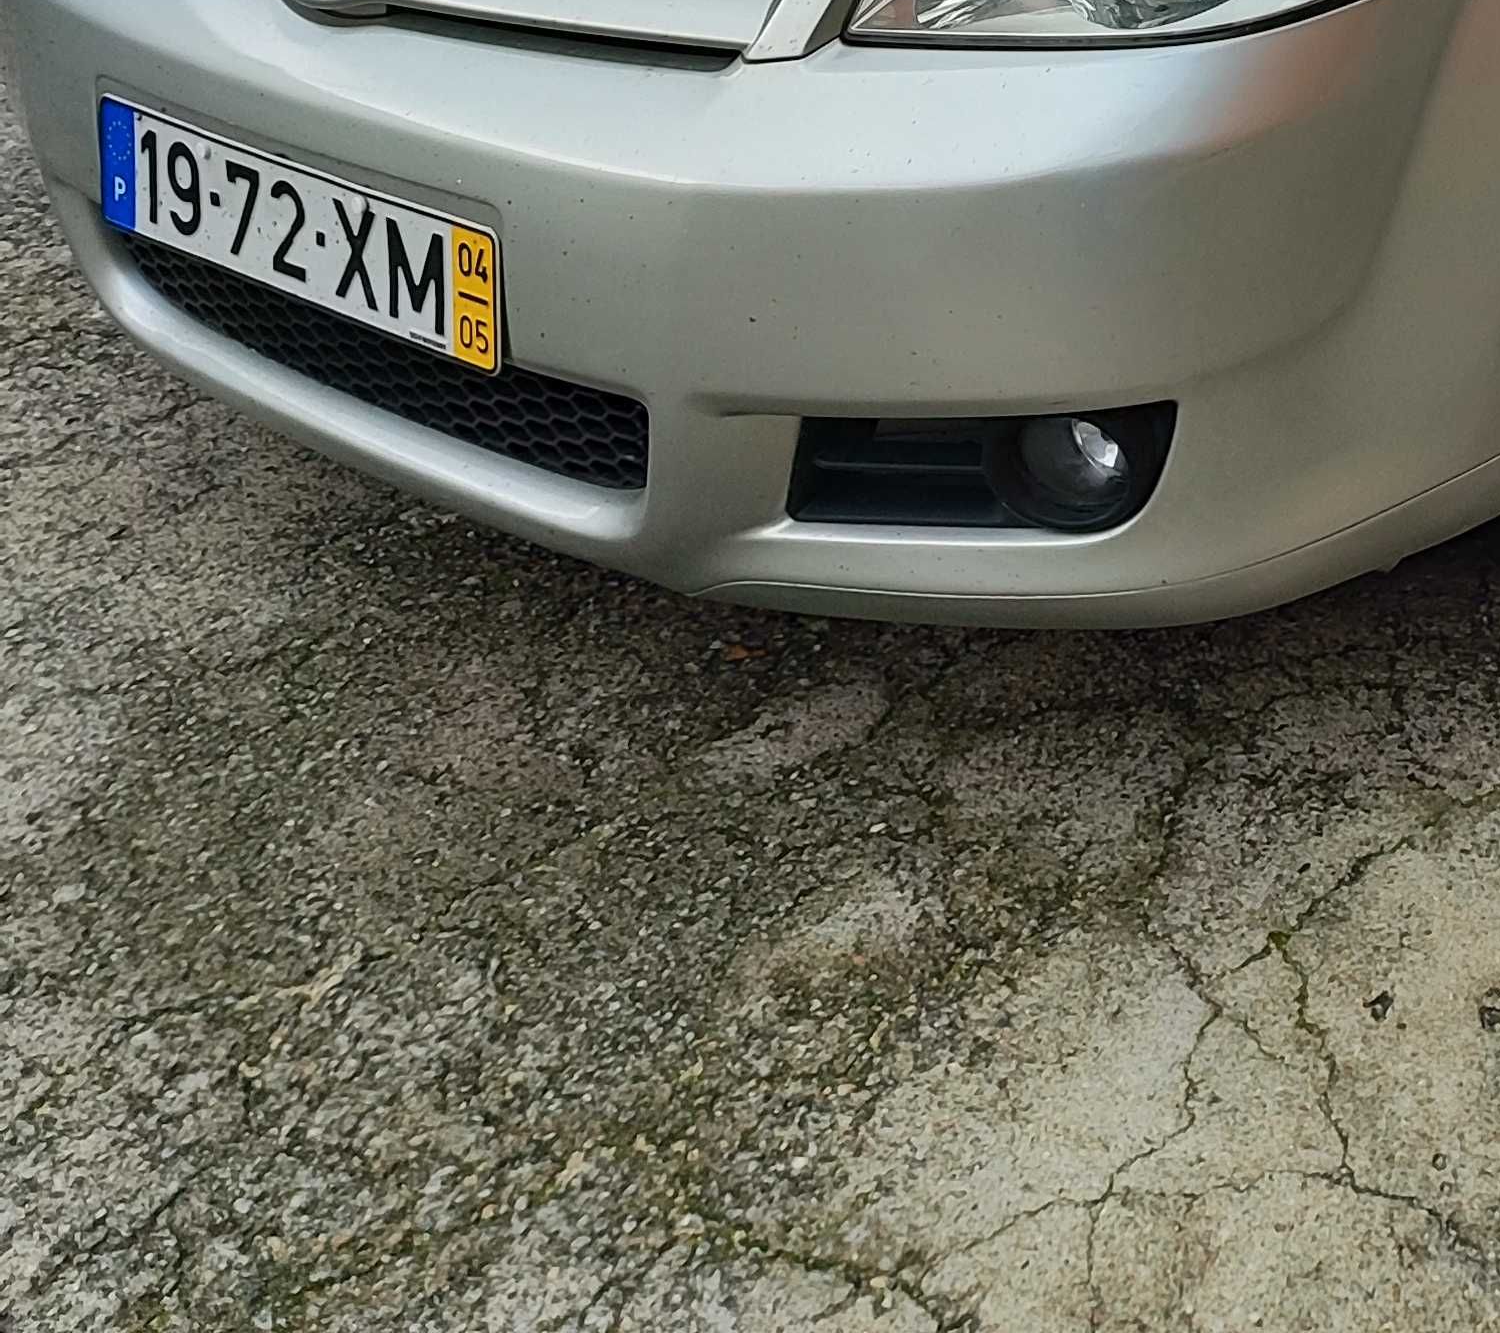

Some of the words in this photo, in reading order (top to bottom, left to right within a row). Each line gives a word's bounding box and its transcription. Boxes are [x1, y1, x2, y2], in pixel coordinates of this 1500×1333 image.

[114, 176, 127, 201] P
[457, 241, 489, 284] 04
[459, 314, 490, 354] 05
